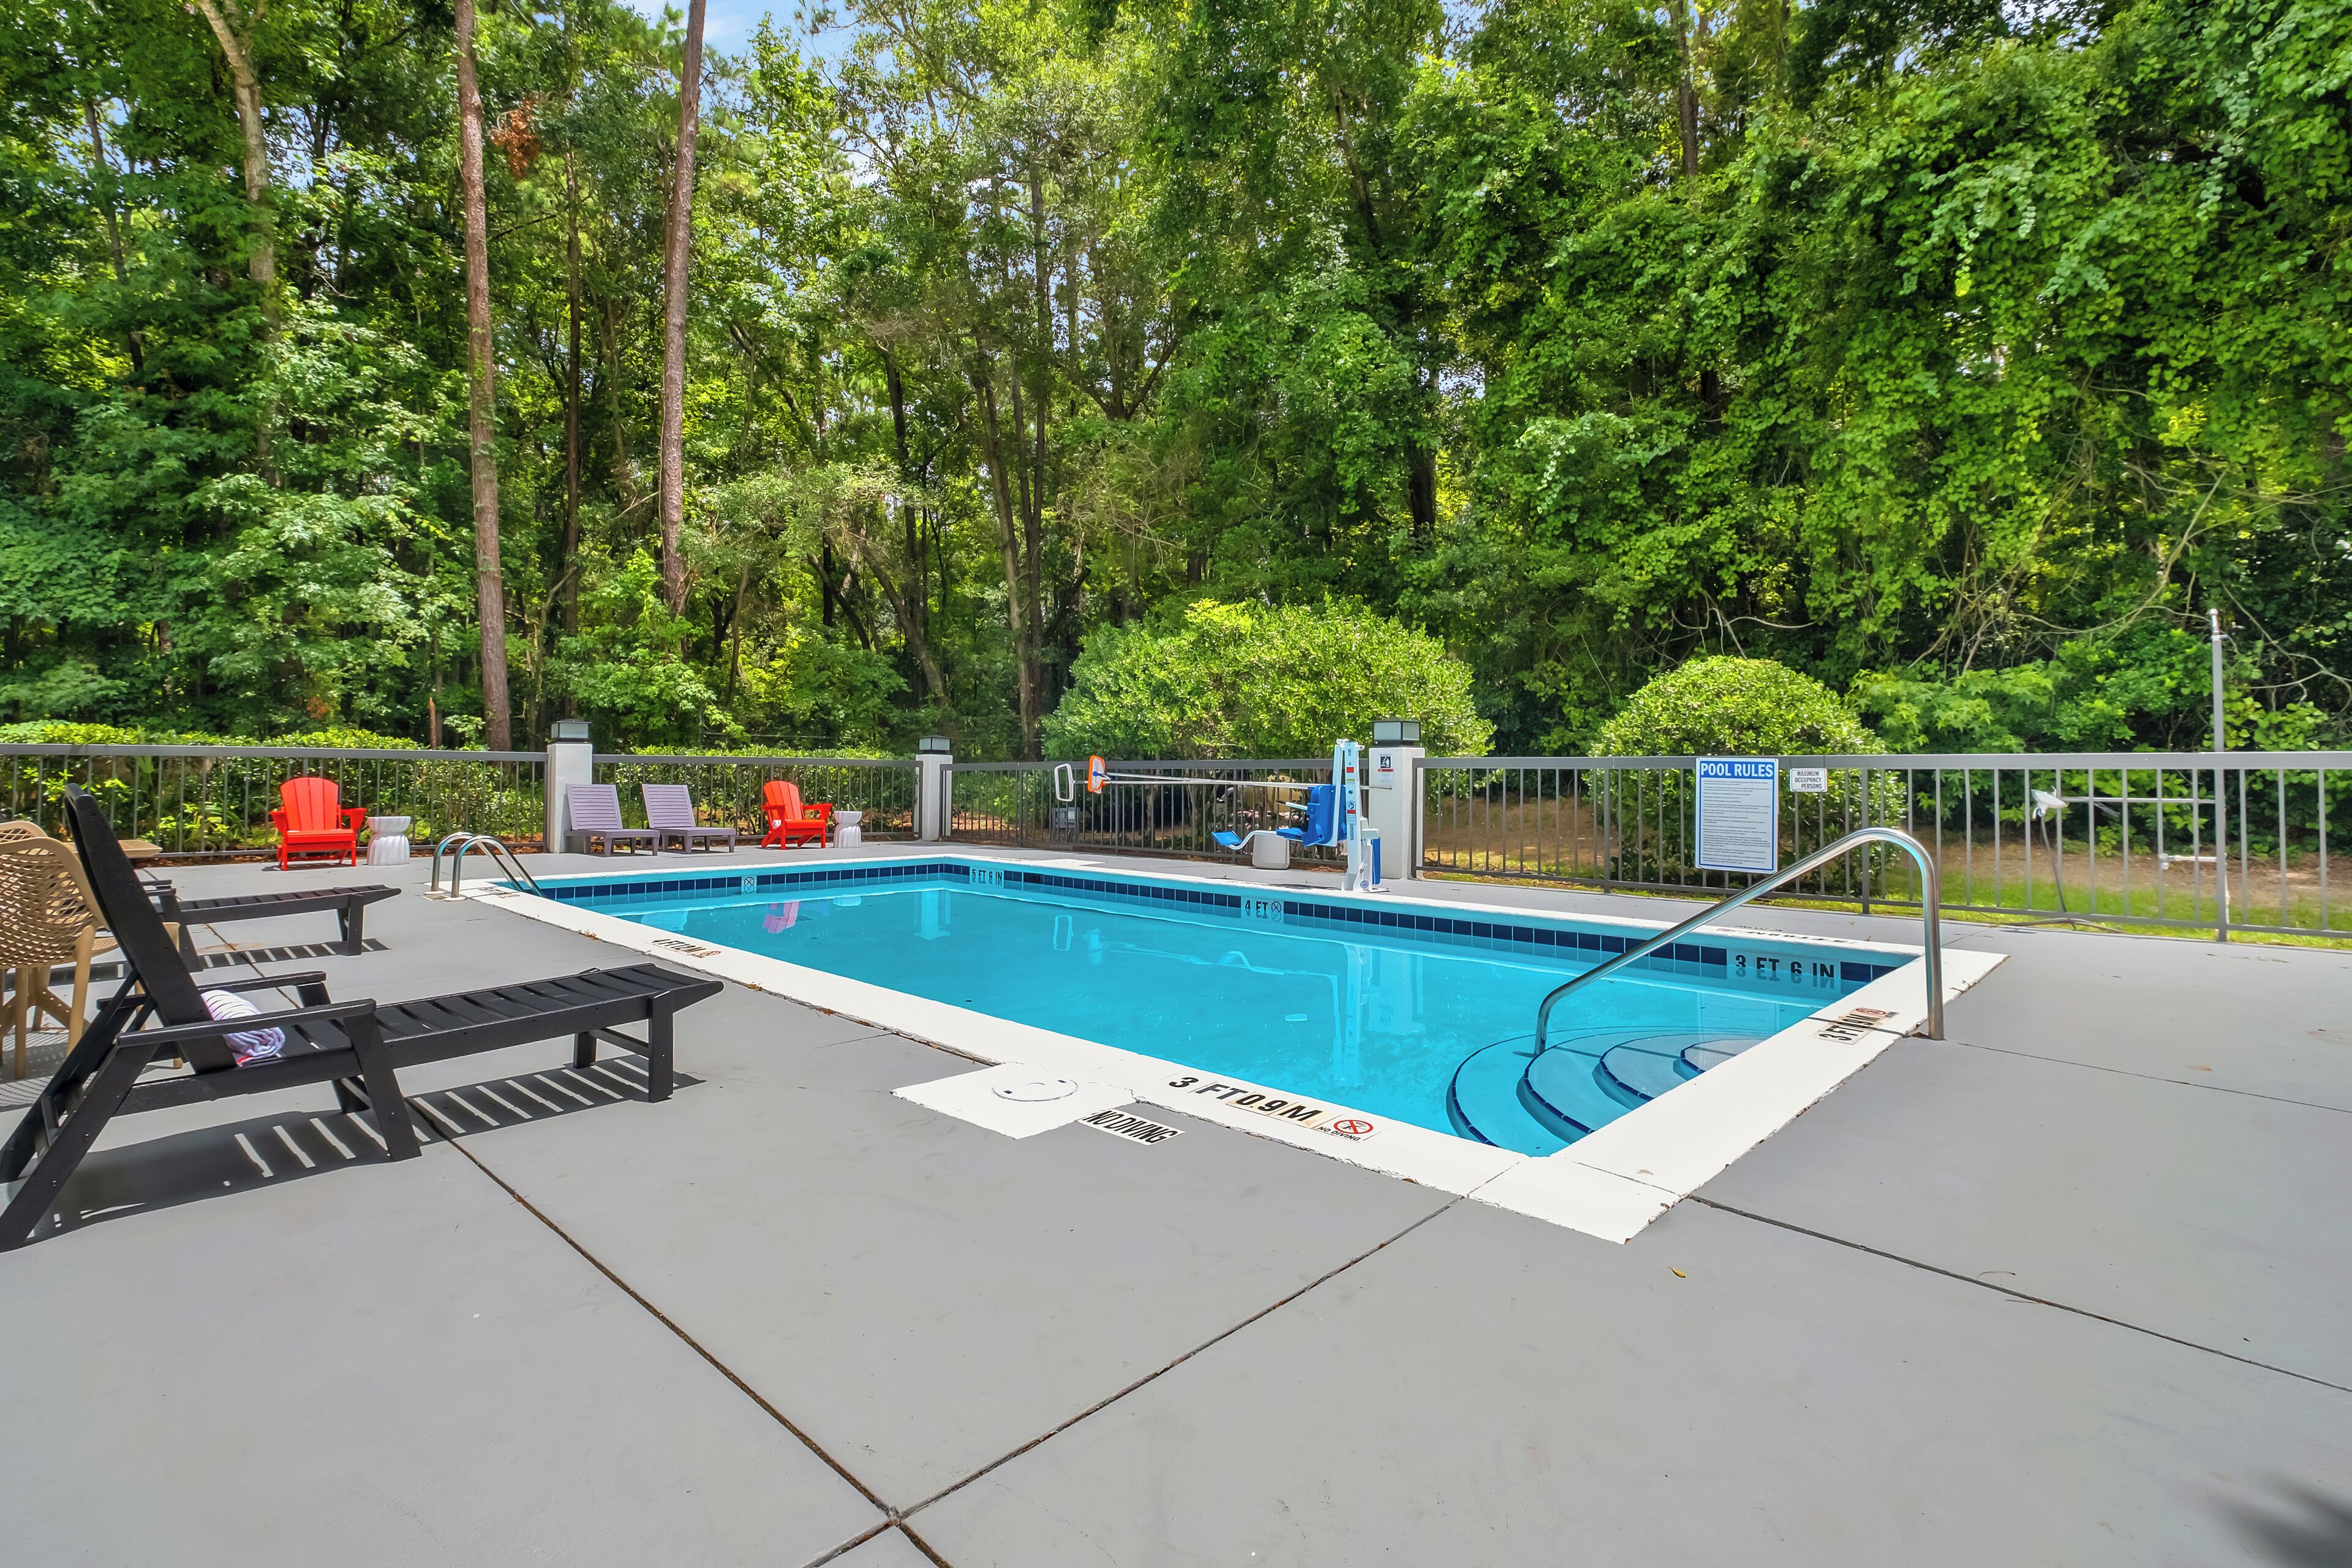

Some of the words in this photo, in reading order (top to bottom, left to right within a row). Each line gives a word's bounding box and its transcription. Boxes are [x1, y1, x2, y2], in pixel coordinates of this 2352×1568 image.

[1701, 763, 1732, 776] POOL
[1734, 763, 1773, 777] RULES
[1245, 900, 1251, 909] 4
[1735, 954, 1746, 968] 3
[1790, 961, 1802, 974] 6
[1813, 962, 1834, 978] IN
[1825, 1025, 1864, 1036] FT
[1845, 1014, 1880, 1022] M
[1169, 1077, 1199, 1088] 3
[1194, 1084, 1249, 1100] FT
[1235, 1094, 1289, 1112] 0.9
[1279, 1105, 1324, 1121] M
[1082, 1110, 1125, 1125] NO
[1103, 1117, 1178, 1144] DIVING
[1331, 1130, 1361, 1141] DIVING
